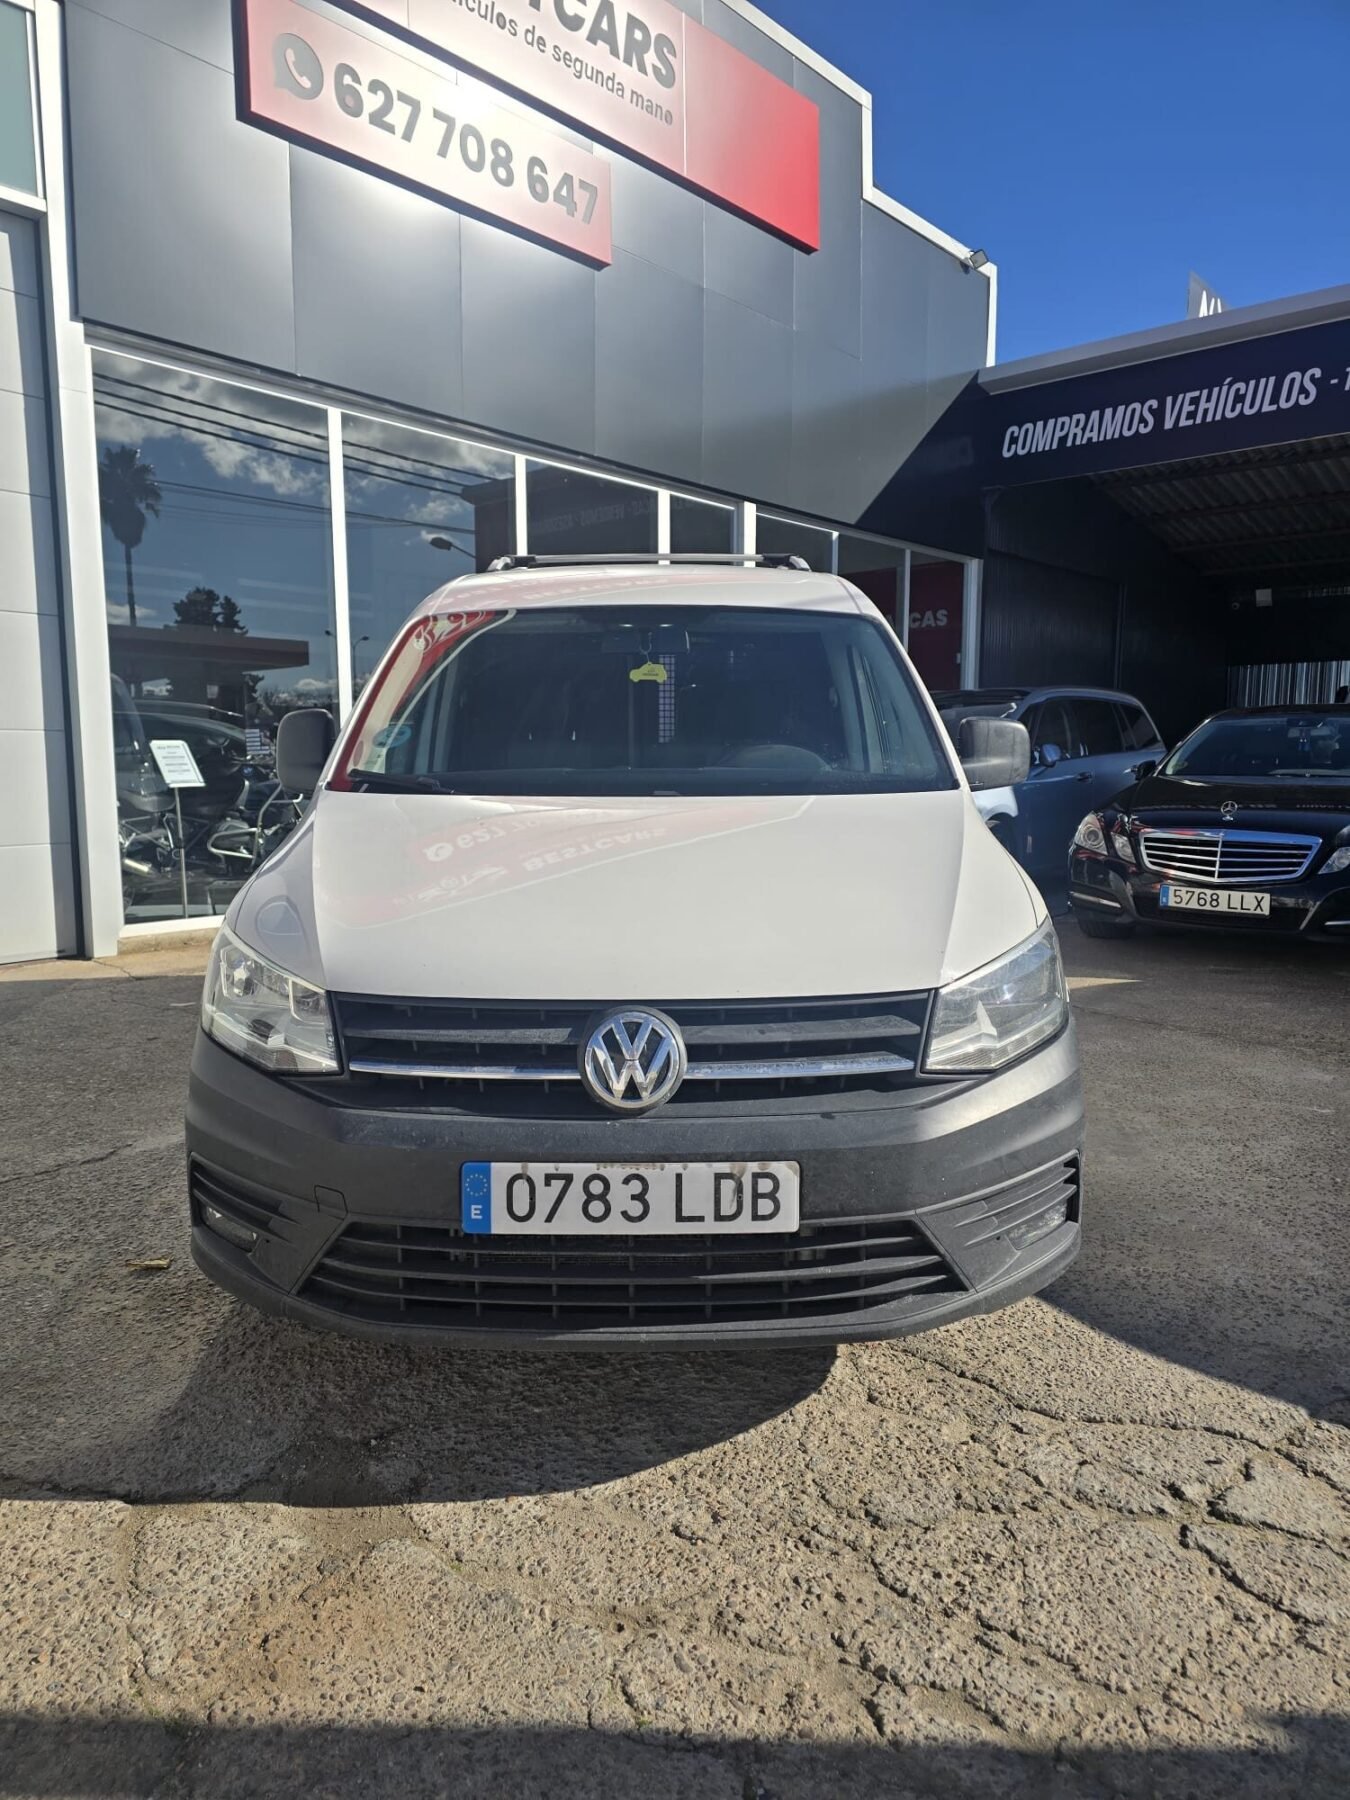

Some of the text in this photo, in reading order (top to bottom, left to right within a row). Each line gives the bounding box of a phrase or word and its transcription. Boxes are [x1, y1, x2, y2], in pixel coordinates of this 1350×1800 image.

[452, 0, 673, 126] culos de segunda mano
[528, 0, 677, 89] CARS
[333, 62, 598, 225] 627 708 647
[1002, 399, 1158, 459] COMPRAMOS
[1163, 367, 1322, 430] VEHÍCULOS
[1173, 889, 1265, 912] 5768 LLX
[471, 1205, 483, 1219] E
[506, 1171, 781, 1223] 0783 LDB
